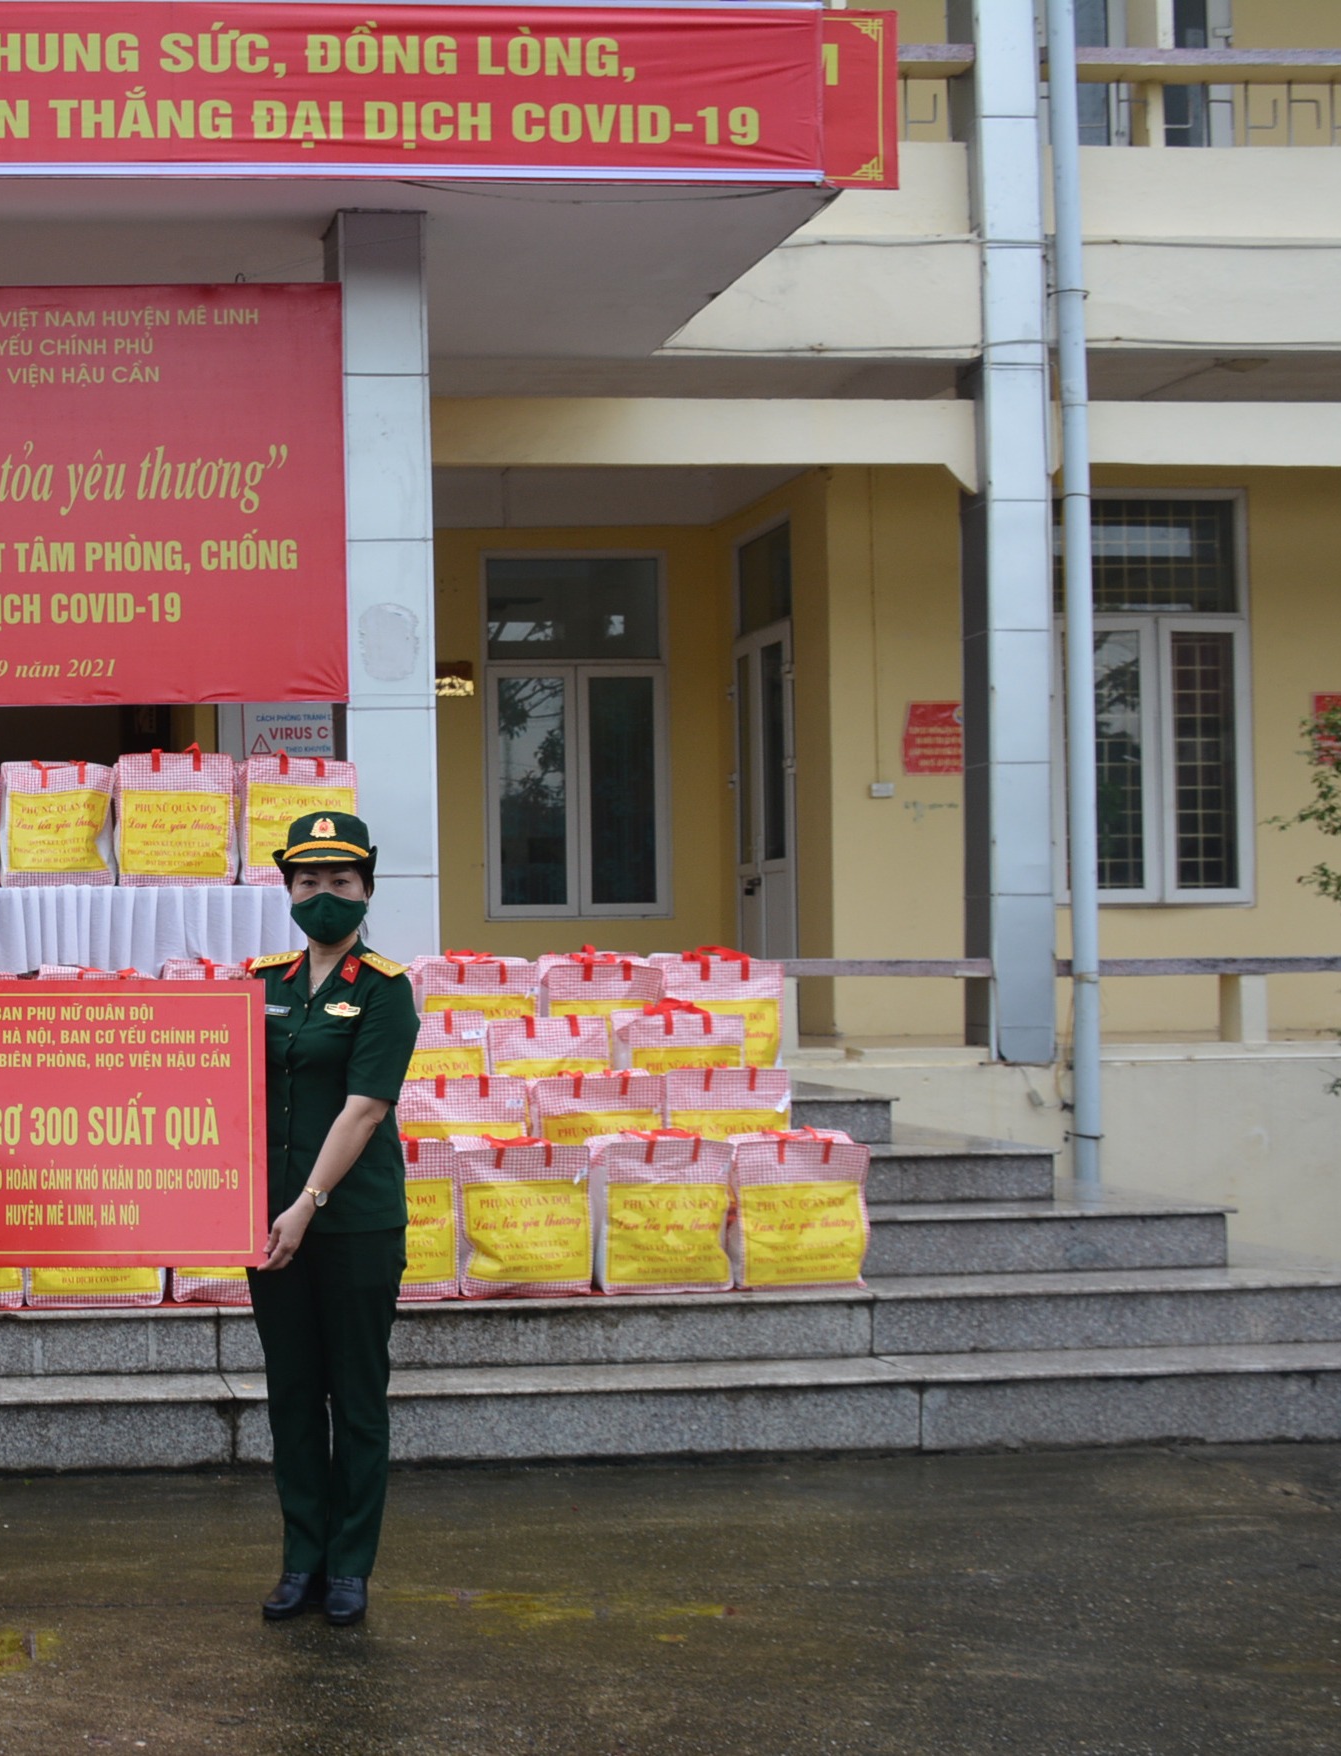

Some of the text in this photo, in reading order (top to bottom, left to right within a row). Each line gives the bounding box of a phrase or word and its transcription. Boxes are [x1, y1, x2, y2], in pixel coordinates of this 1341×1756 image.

[159, 21, 287, 79] SỨC,
[304, 20, 458, 75] ĐỒNG
[477, 26, 636, 82] LÒNG,
[48, 88, 234, 140] THẮNG
[250, 99, 345, 149] ĐẠI
[364, 100, 492, 149] DỊCH
[512, 102, 760, 146] COVID-19
[44, 309, 97, 328] NAM
[101, 305, 172, 334] HUYỆN
[176, 304, 208, 326] MÊ
[213, 307, 260, 326] LINH
[39, 333, 108, 357] CHÍNH
[113, 332, 154, 356] PHỦ
[6, 363, 56, 388] VIỆN
[61, 362, 106, 387] HẬU
[110, 360, 161, 384] CẦN
[59, 448, 127, 516] yêu
[136, 443, 289, 514] thương”
[13, 535, 76, 573] TÂM
[84, 533, 192, 574] PHÒNG,
[200, 528, 299, 571] CHỐNG
[50, 591, 182, 624] COVID-19
[15, 661, 61, 679] năm
[66, 657, 116, 678] 2021
[268, 726, 313, 740] VIRUS
[27, 1006, 57, 1024] PHỤ
[60, 1005, 84, 1021] NỮ
[85, 1003, 126, 1022] QUÂN
[129, 1003, 155, 1024] ĐỘI
[2, 1028, 23, 1045] HÀ
[26, 1027, 56, 1047] NỘI,
[60, 1029, 91, 1045] BAN
[94, 1028, 116, 1045] CƠ
[118, 1024, 147, 1045] YẾU
[150, 1026, 196, 1045] CHÍNH
[199, 1023, 230, 1045] PHỦ
[36, 1050, 91, 1069] PHÒNG,
[95, 1052, 125, 1071] HỌC
[128, 1050, 163, 1071] VIỆN
[166, 1050, 197, 1071] HẬU
[29, 1106, 79, 1146] 300
[87, 1091, 157, 1146] SUẤT
[165, 1098, 220, 1151] QUÀ
[5, 1168, 38, 1190] HOÀN
[40, 1159, 73, 1190] CẢNH
[74, 1164, 100, 1191] KHÓ
[101, 1164, 135, 1191] KHĂN
[136, 1167, 154, 1191] DO
[155, 1167, 184, 1194] DỊCH
[185, 1167, 240, 1191] COVID-19
[5, 1199, 141, 1231] HUYỆN MÊ LINH, HÀ NỘI
